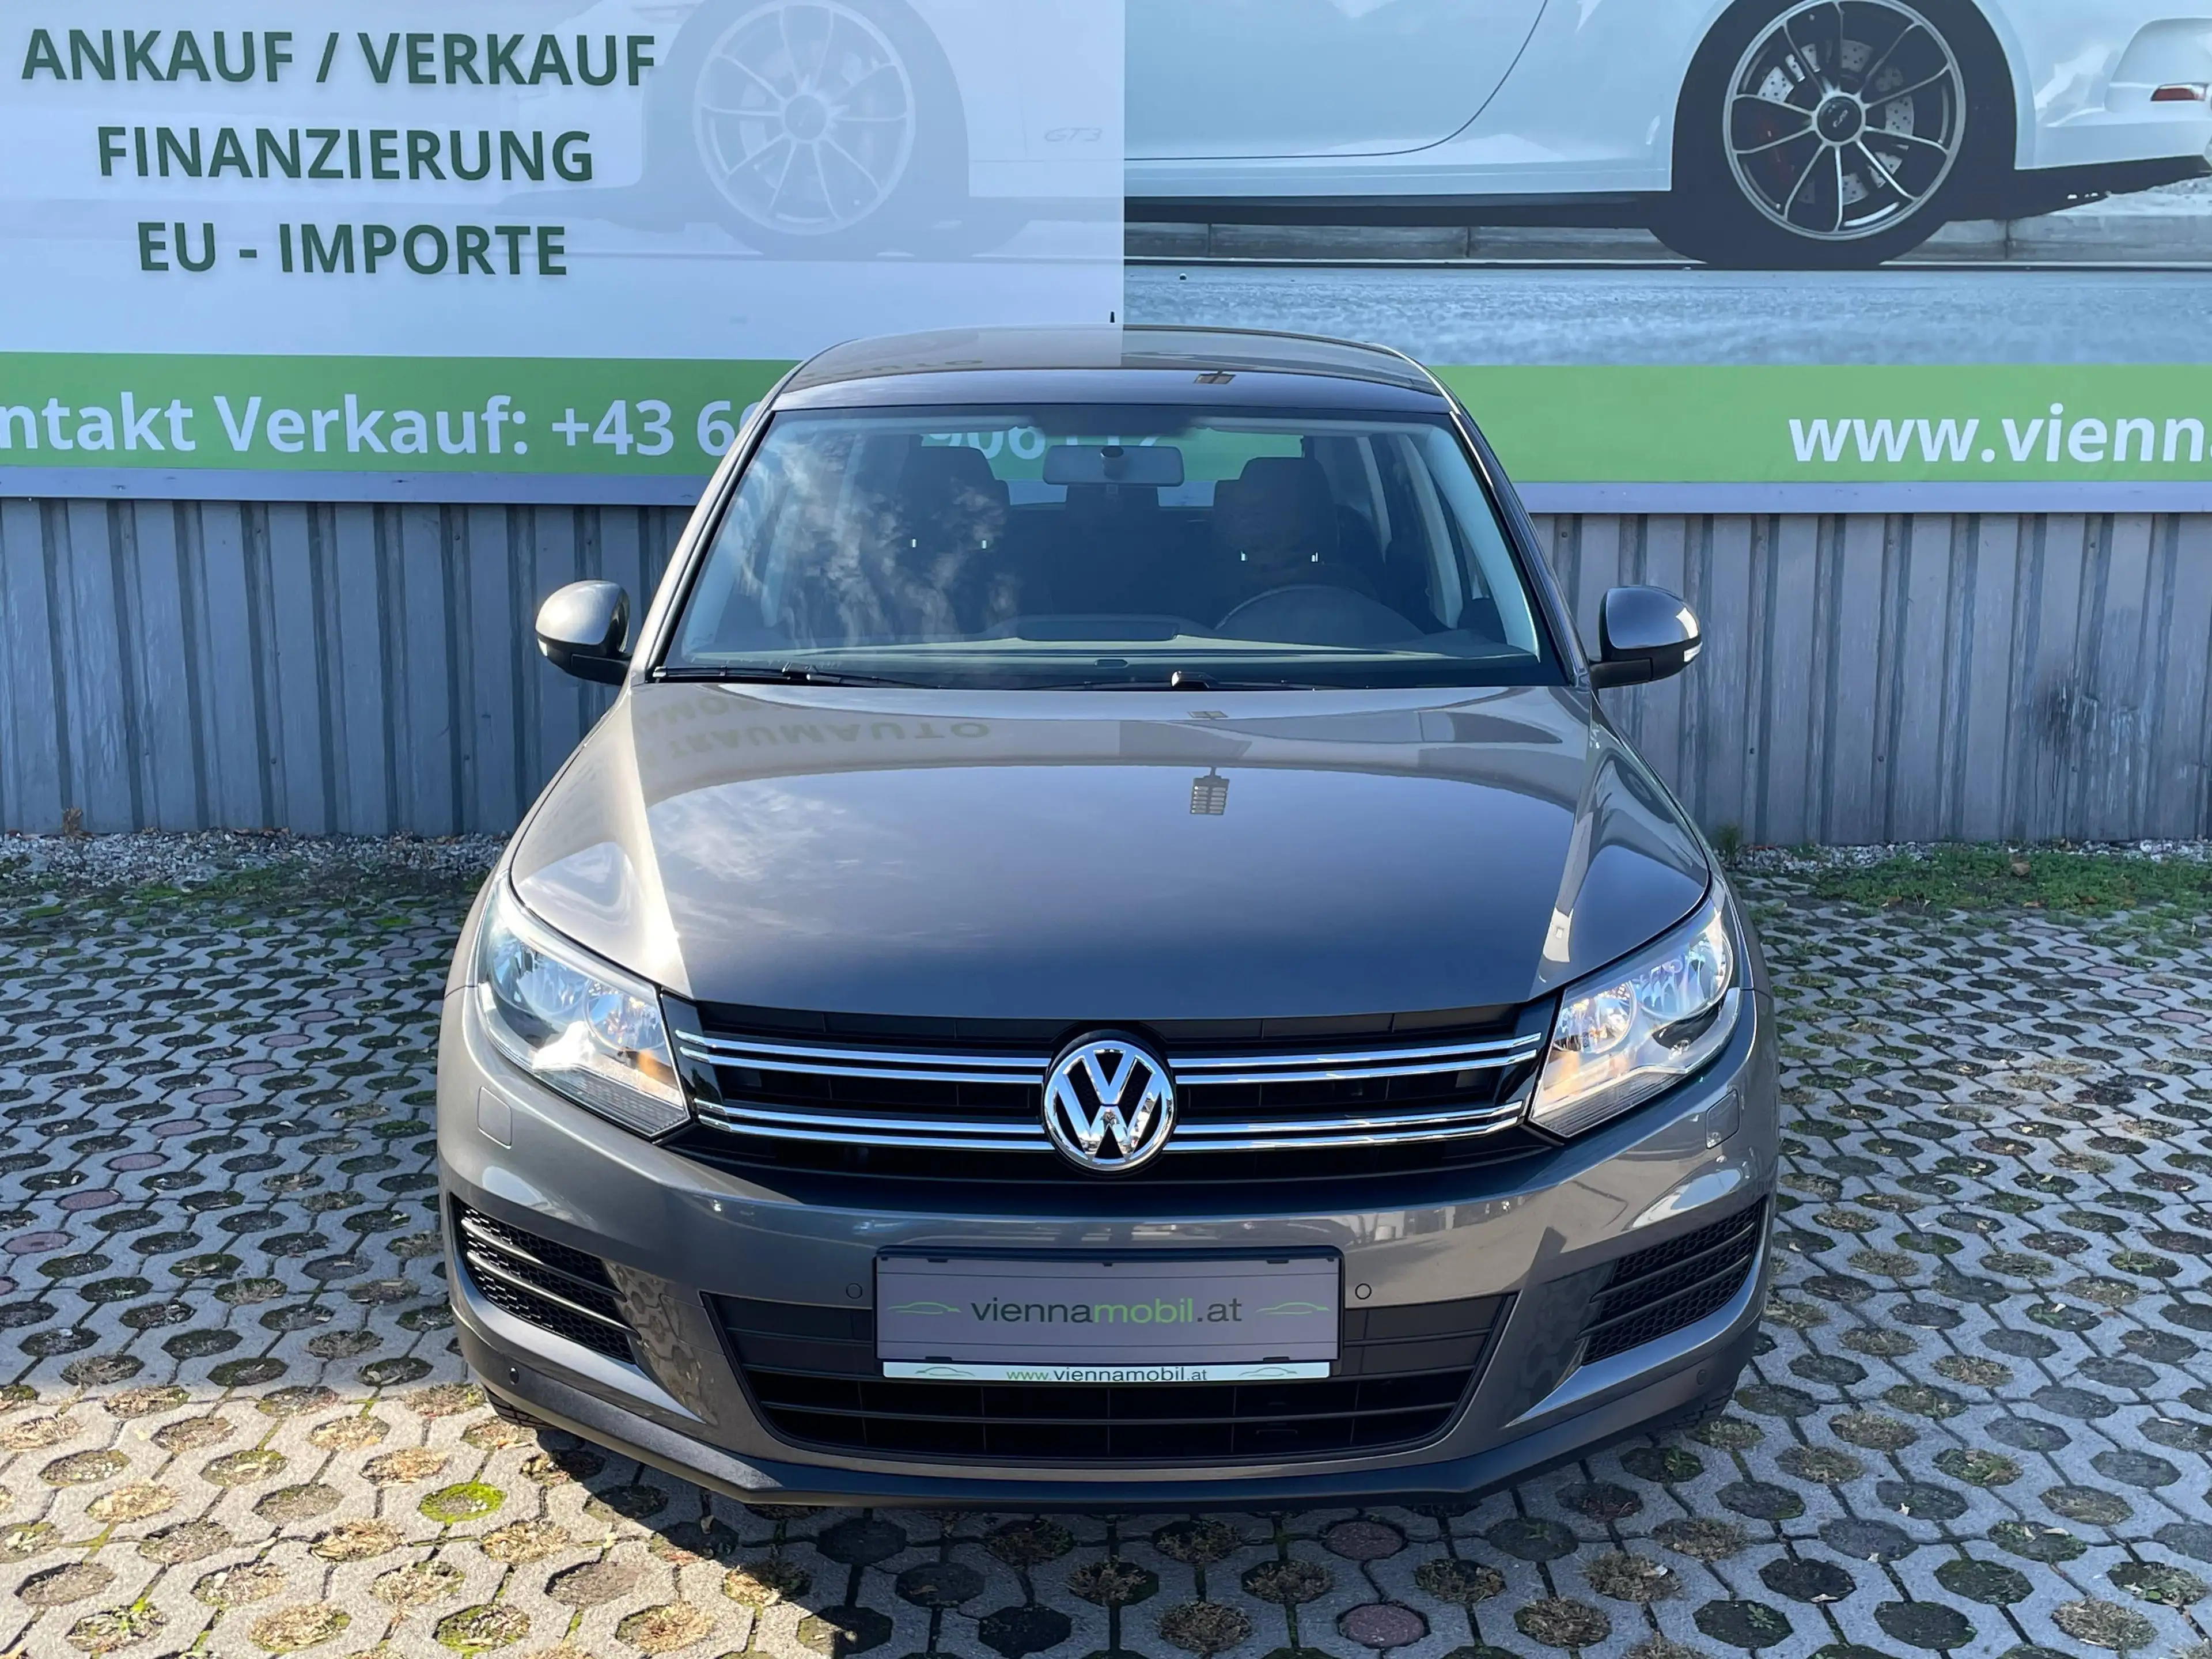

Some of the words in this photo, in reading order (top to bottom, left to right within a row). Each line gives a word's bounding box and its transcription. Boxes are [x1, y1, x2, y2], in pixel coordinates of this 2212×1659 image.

[21, 29, 293, 82] ANKAUF
[316, 32, 340, 83] /
[357, 33, 655, 86] VERKAUF
[97, 126, 593, 181] FINANZIERUNG
[1044, 127, 1103, 142] GT3
[137, 222, 216, 272] EU
[239, 249, 257, 259] -
[279, 224, 567, 275] IMPORTE
[0, 391, 196, 451] ntakt
[214, 394, 528, 454] Verkauf:
[551, 399, 674, 456] +43
[1789, 403, 2212, 463] www.vienn
[1046, 1040, 1177, 1172] VW
[971, 1297, 1243, 1324] viennamobil.at
[1006, 1366, 1208, 1382] www.viennamobil.at
